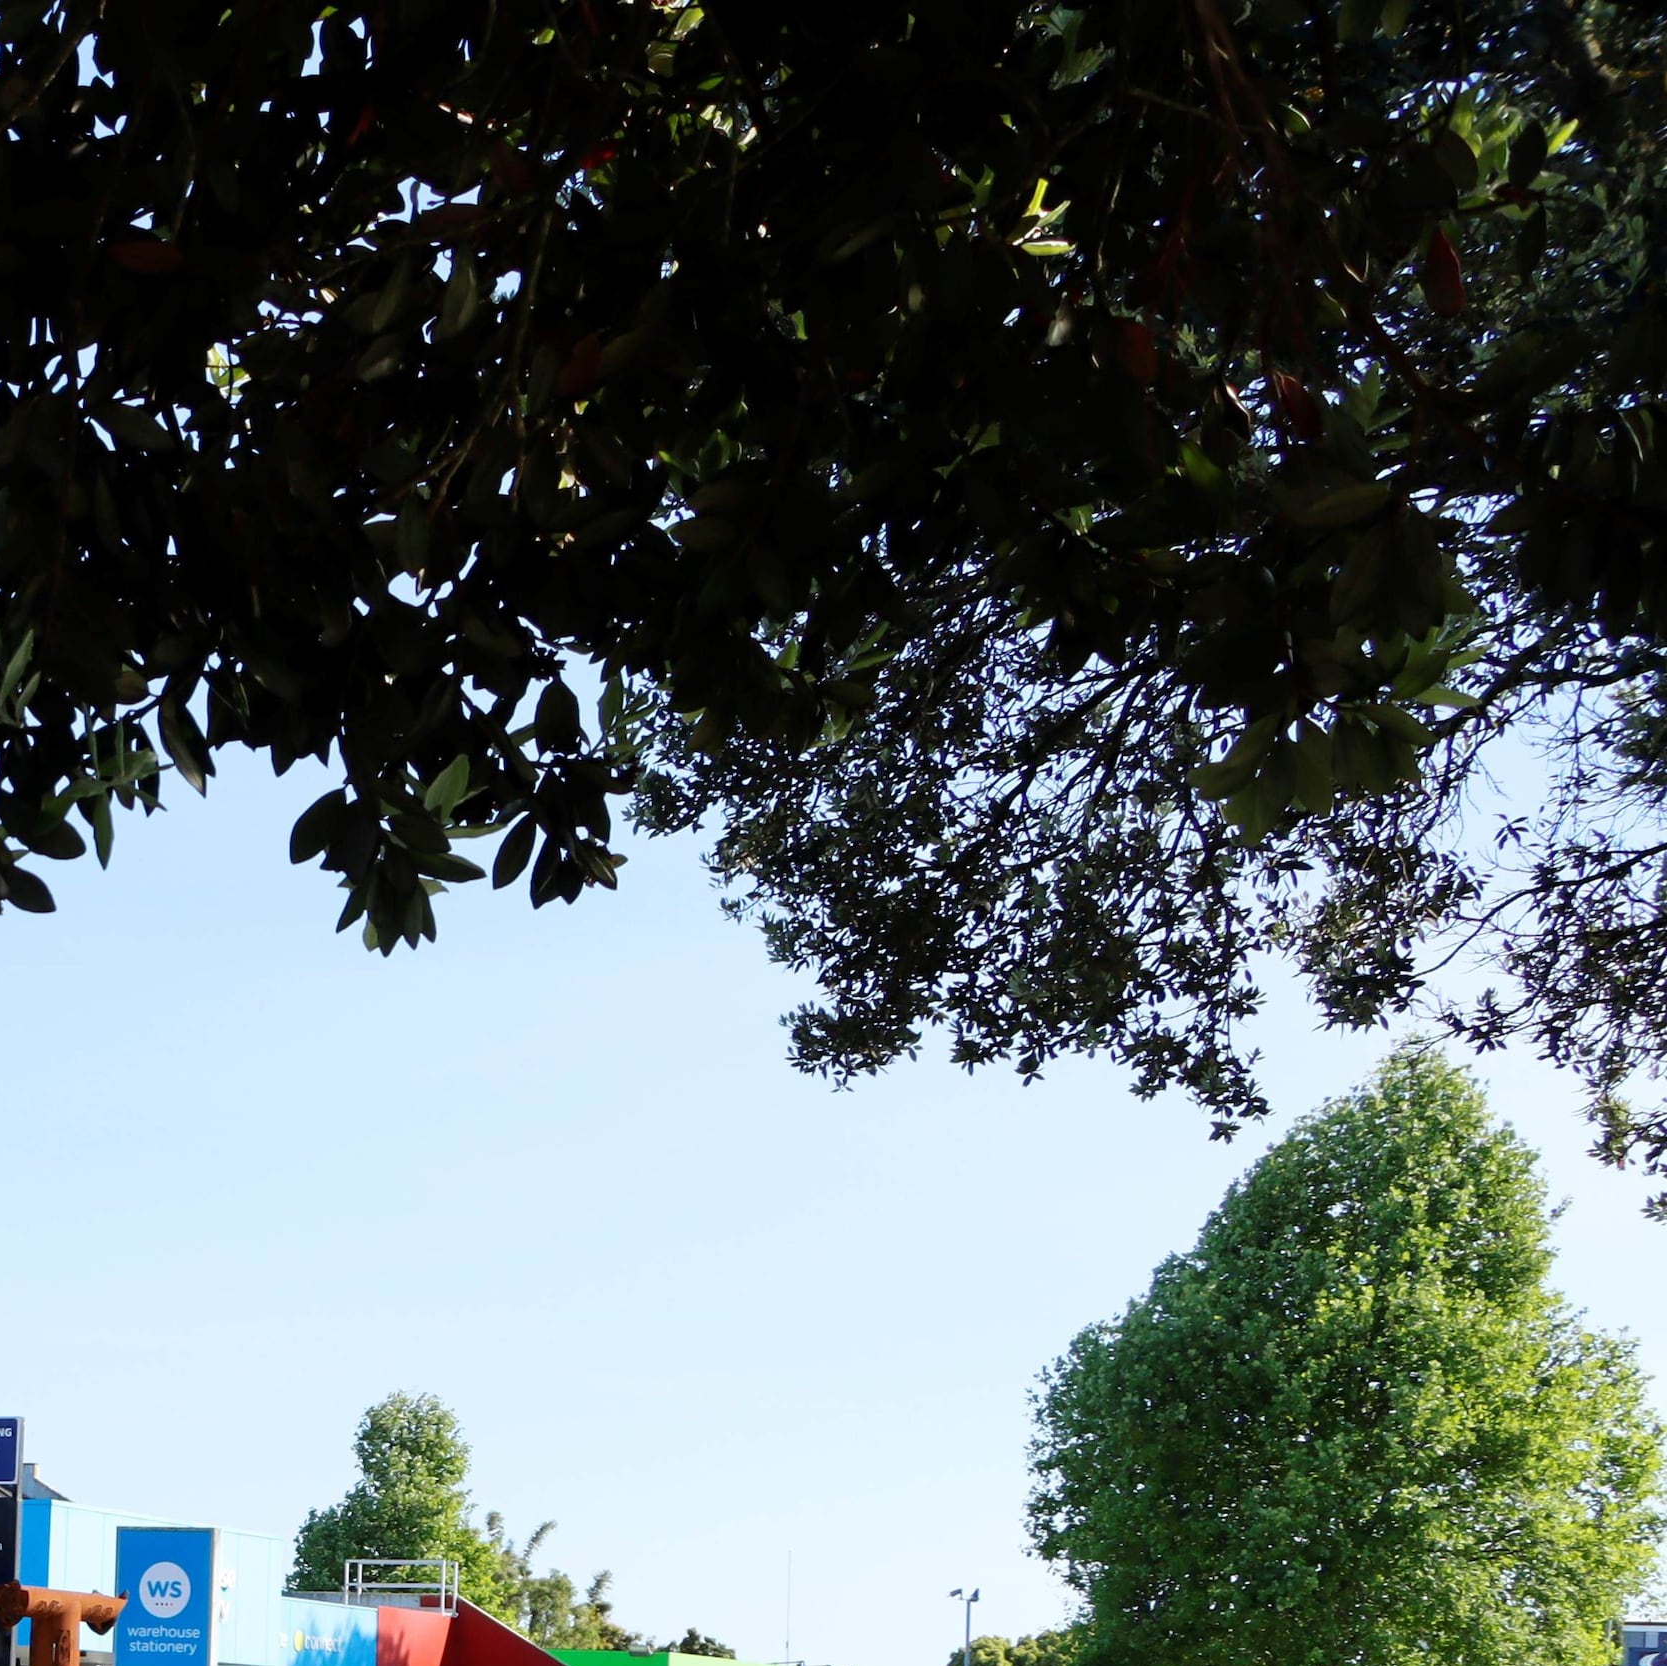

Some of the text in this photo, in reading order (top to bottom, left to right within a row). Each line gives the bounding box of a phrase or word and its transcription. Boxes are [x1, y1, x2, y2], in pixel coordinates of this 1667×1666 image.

[147, 1580, 184, 1599] WS
[126, 1624, 201, 1639] warehouse
[128, 1639, 198, 1655] stationery
